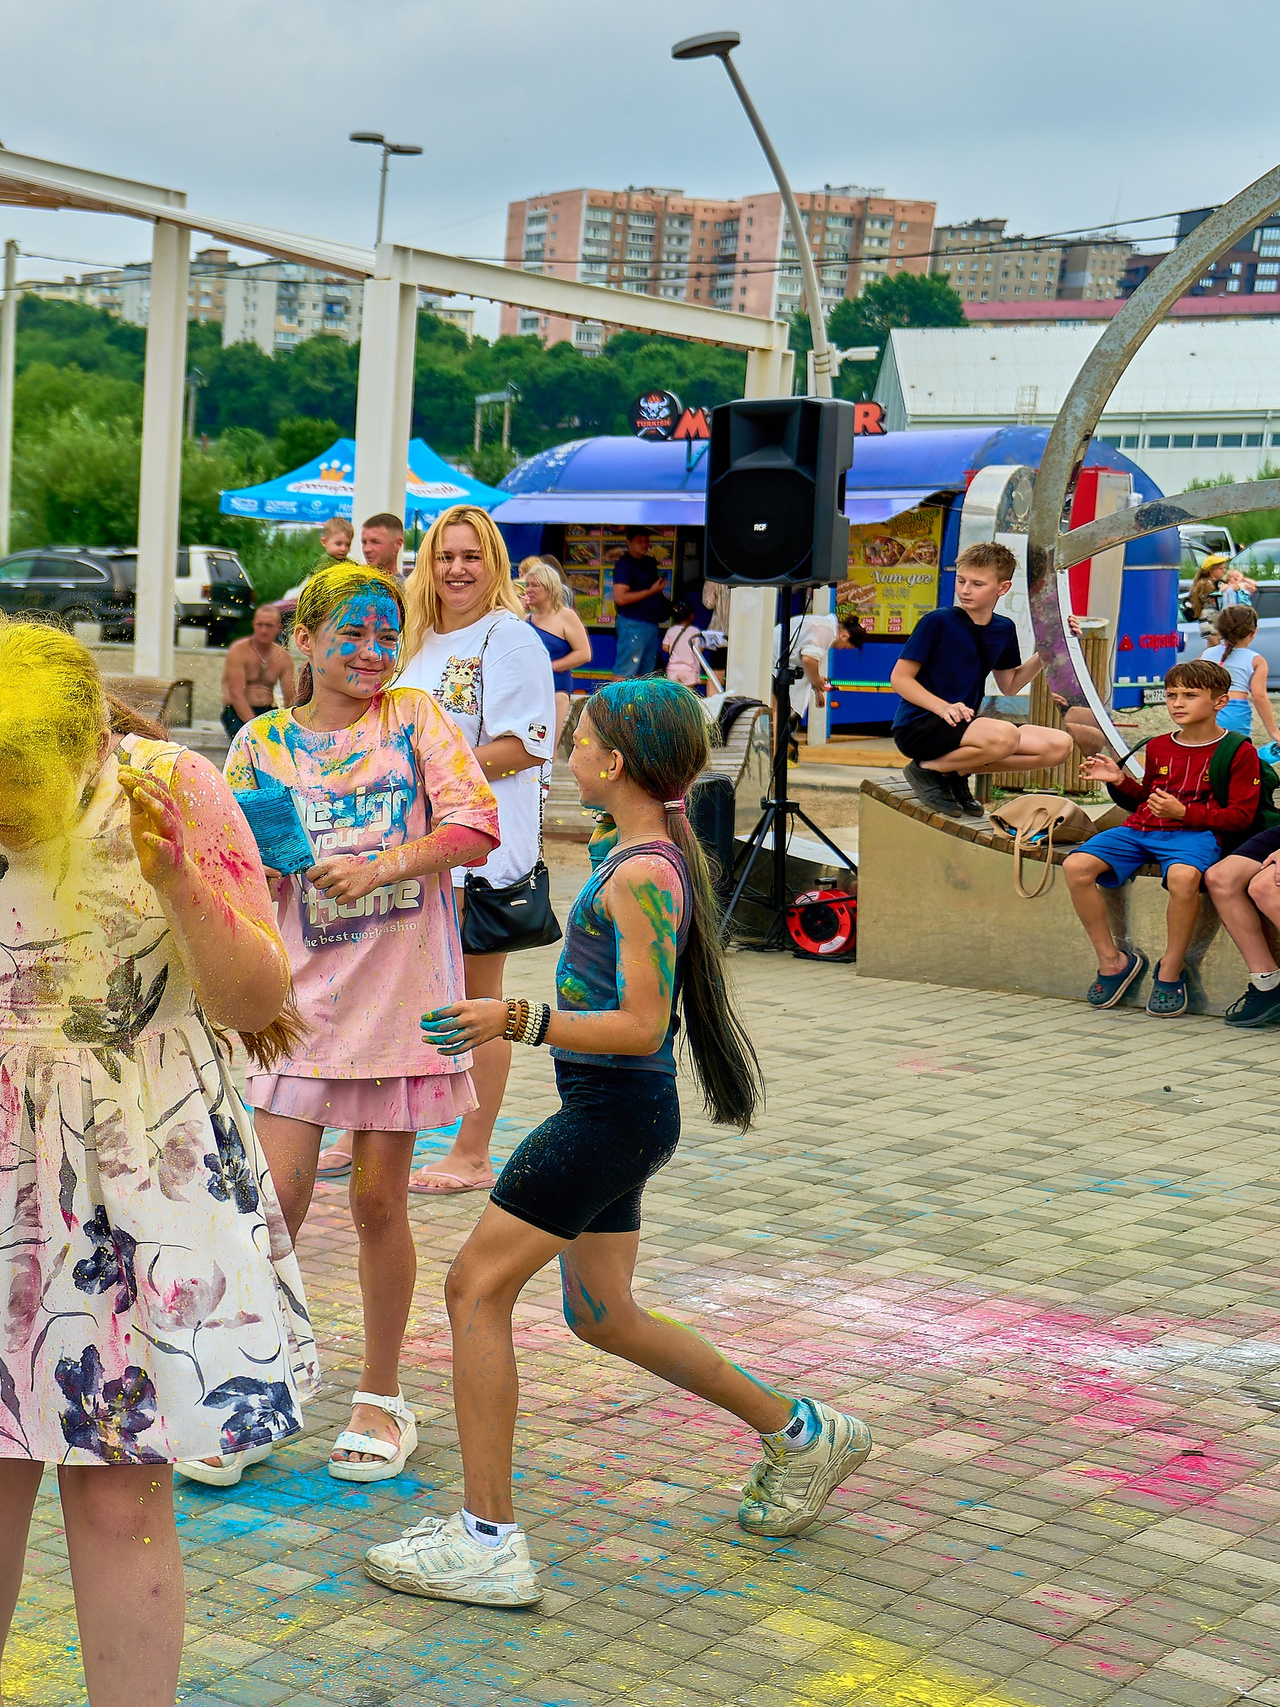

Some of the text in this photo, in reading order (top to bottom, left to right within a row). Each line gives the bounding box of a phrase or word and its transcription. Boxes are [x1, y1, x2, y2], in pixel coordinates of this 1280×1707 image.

[636, 418, 671, 429] TURKISH
[297, 785, 413, 833] esign
[313, 827, 366, 857] your
[320, 931, 349, 946] best
[382, 918, 420, 934] ashio
